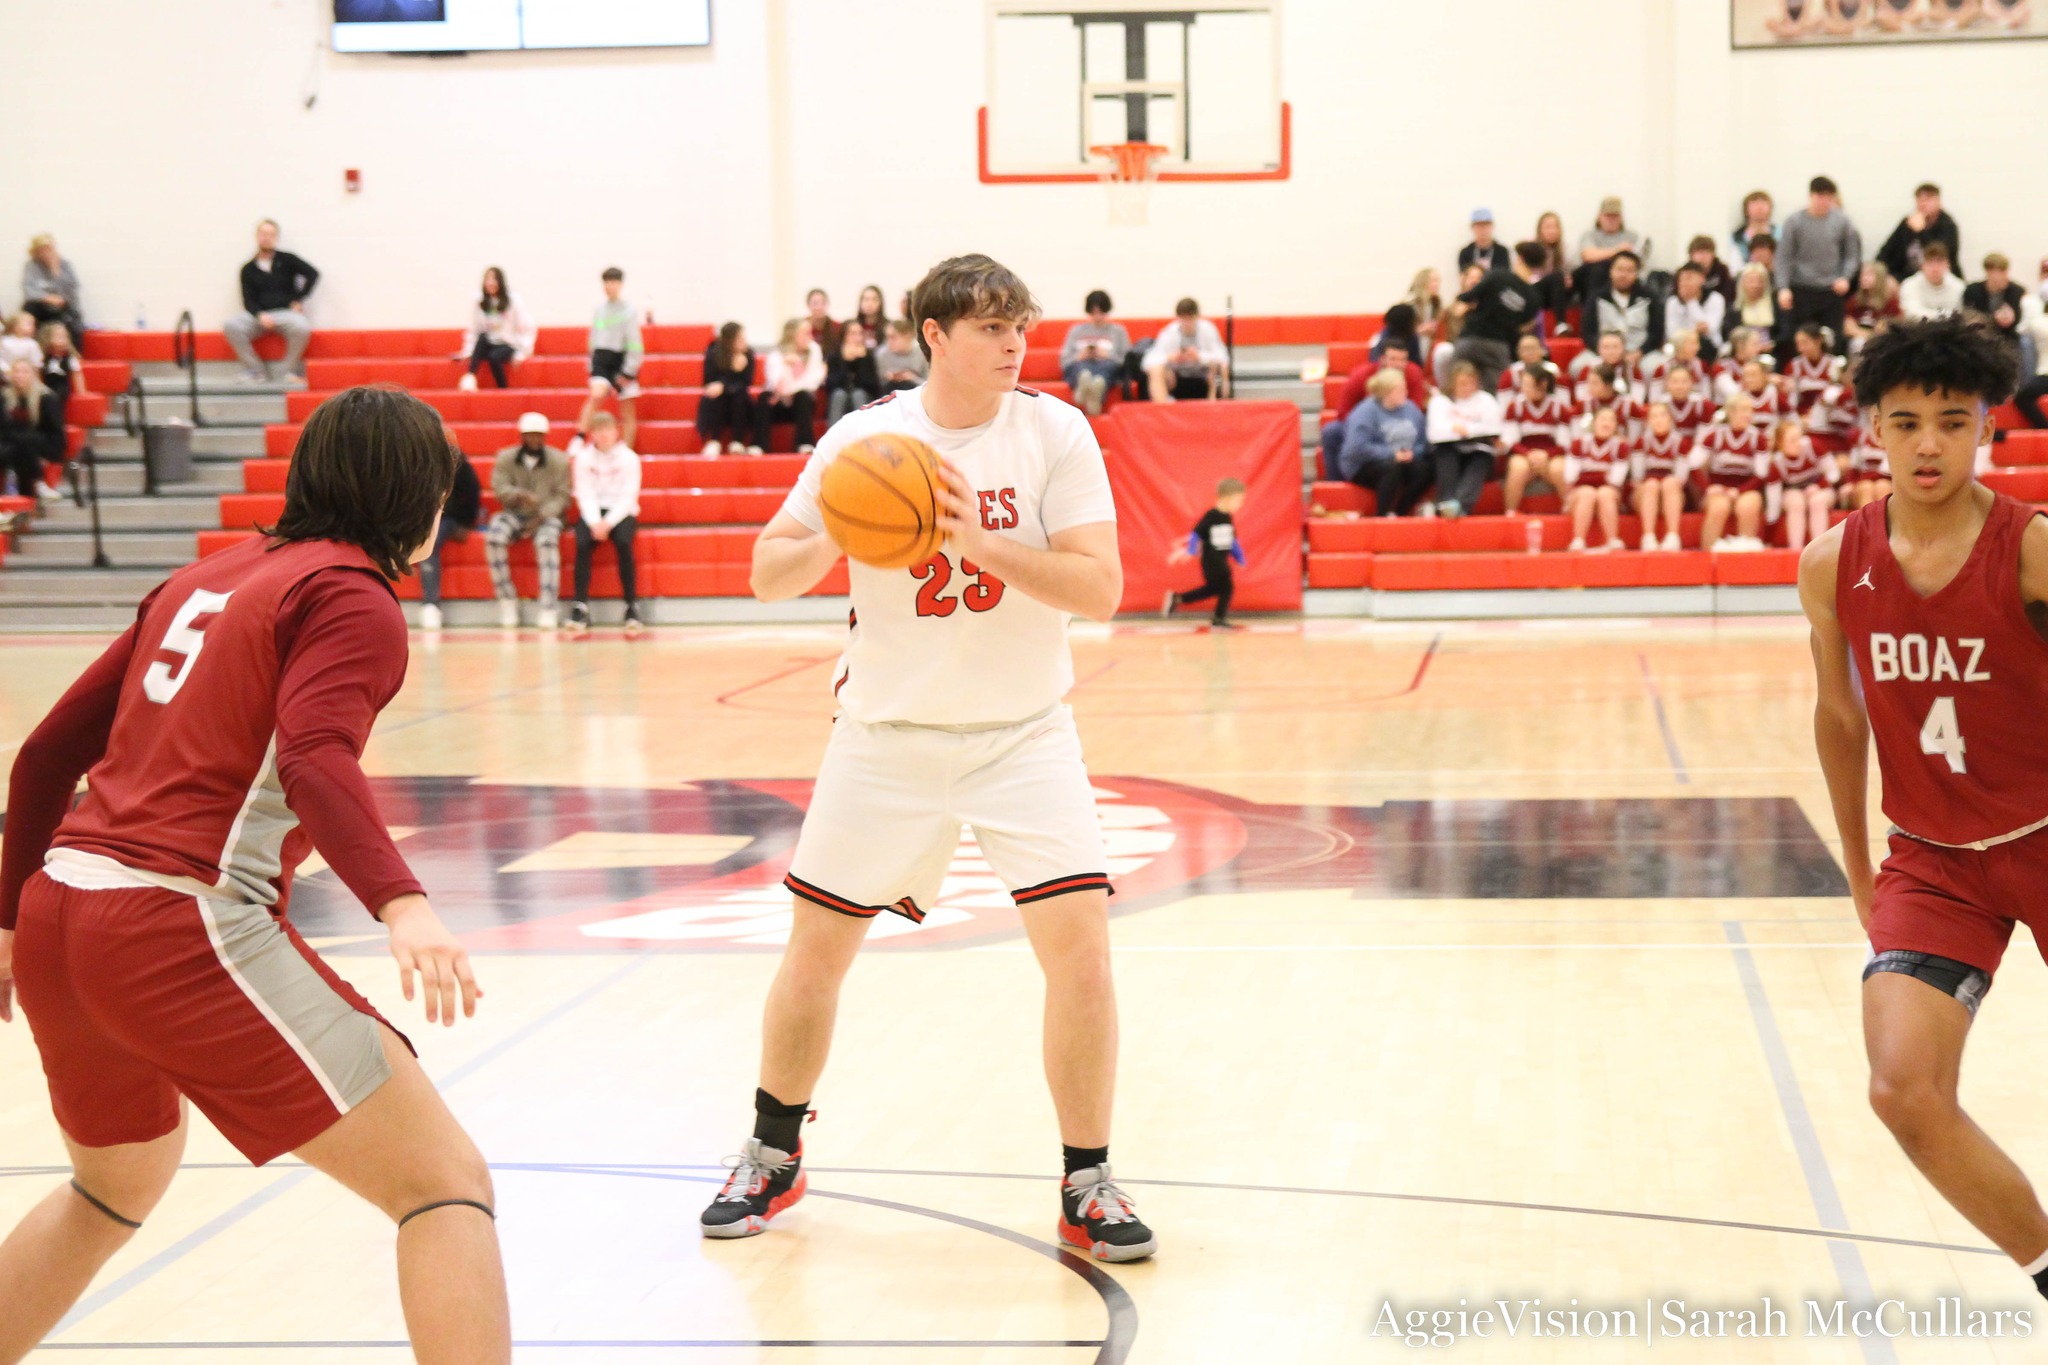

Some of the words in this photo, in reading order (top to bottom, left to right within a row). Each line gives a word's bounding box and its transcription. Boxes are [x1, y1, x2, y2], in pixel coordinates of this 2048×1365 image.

[909, 551, 1006, 617] 23
[143, 588, 236, 704] 5
[1870, 632, 1991, 682] BOAZ
[1919, 696, 1967, 774] 4
